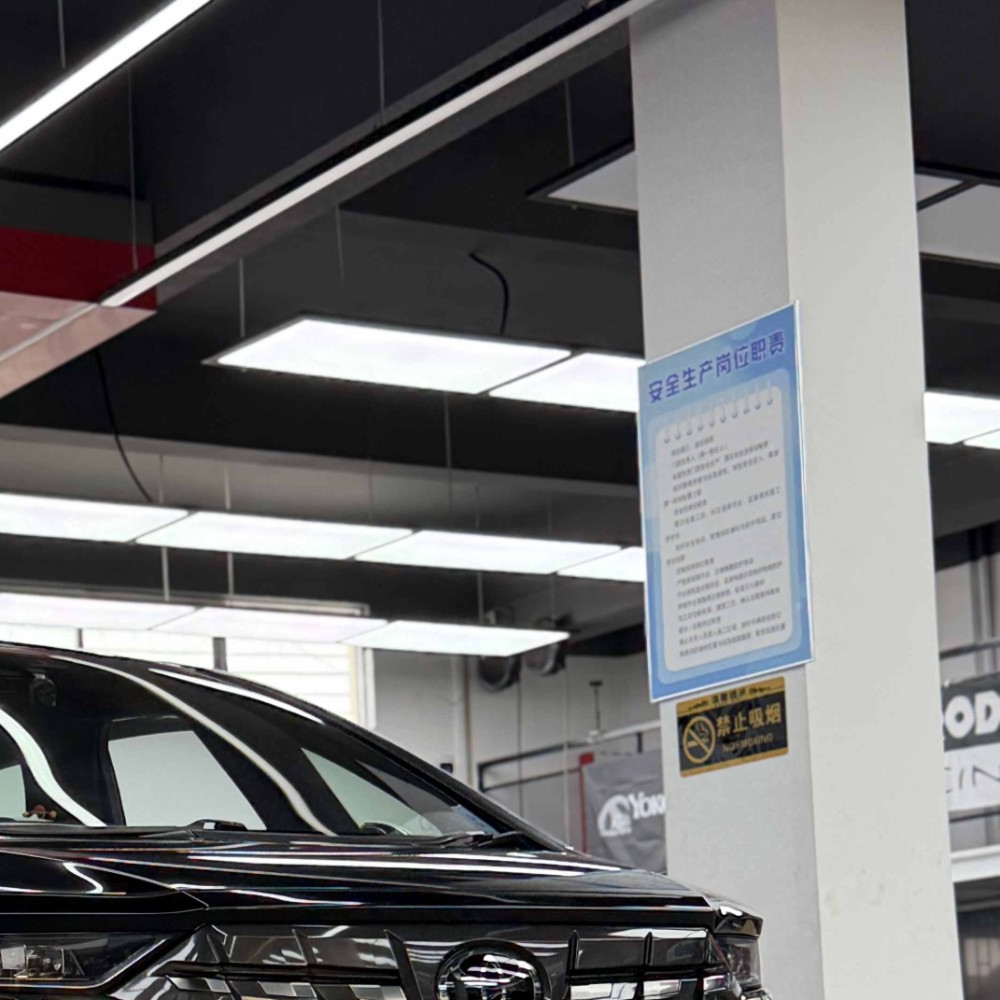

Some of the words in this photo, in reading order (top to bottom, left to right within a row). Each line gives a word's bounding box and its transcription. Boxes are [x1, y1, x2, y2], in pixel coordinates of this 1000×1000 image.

[648, 331, 785, 403] 安全生产岗位职责
[716, 703, 781, 737] 禁止吸烟
[628, 792, 666, 819] YOK
